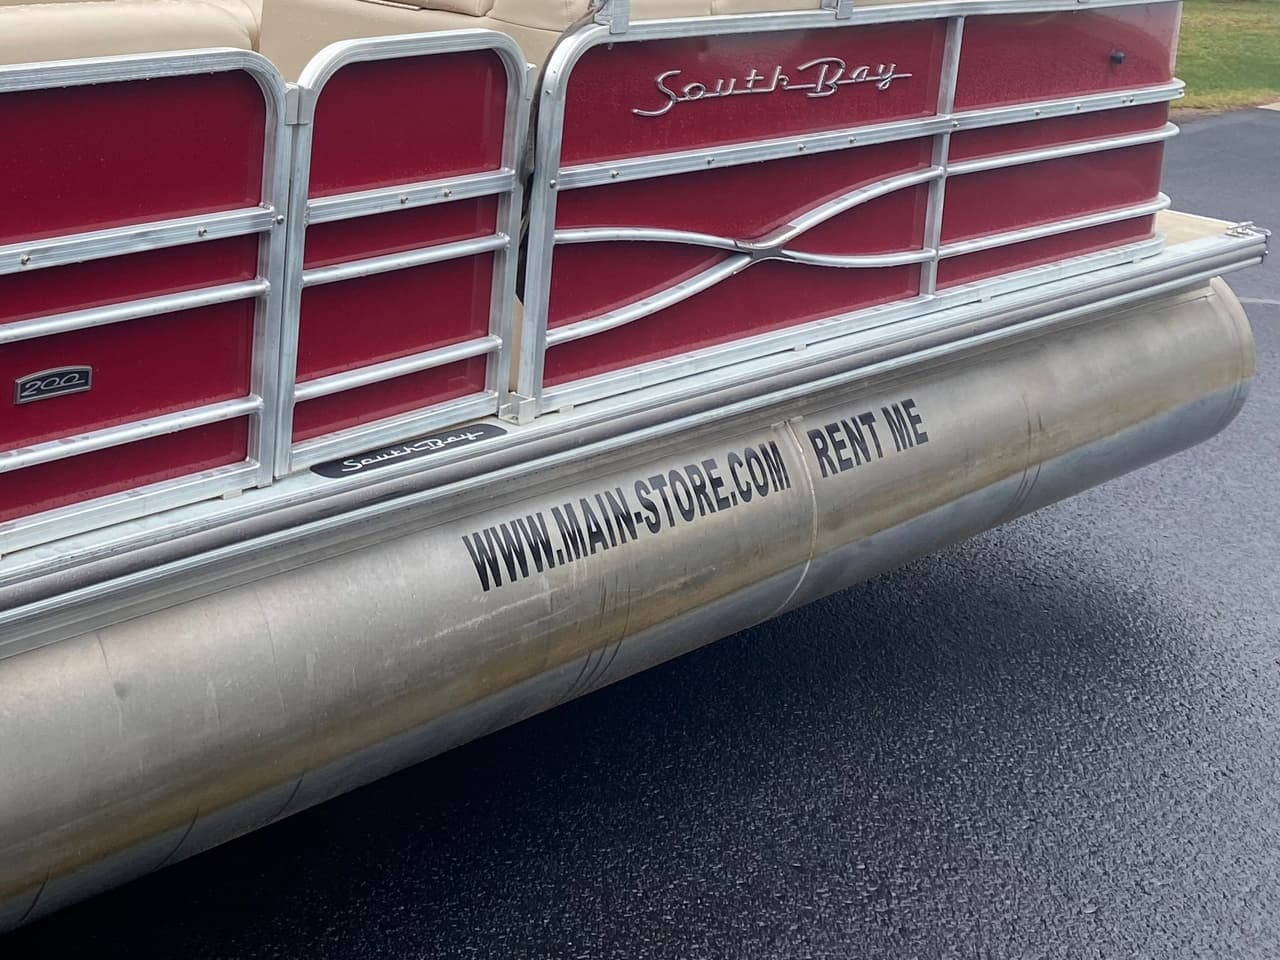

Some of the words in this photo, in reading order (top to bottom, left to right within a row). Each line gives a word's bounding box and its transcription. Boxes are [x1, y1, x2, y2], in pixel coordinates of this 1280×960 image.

[631, 65, 790, 117] South
[797, 57, 912, 98] Bay
[21, 373, 85, 396] 200
[341, 444, 419, 471] South
[418, 431, 484, 450] Bay
[461, 440, 791, 592] WWW.MAIN-STORE.COM
[806, 411, 884, 478] RENT
[881, 398, 929, 453] ME
